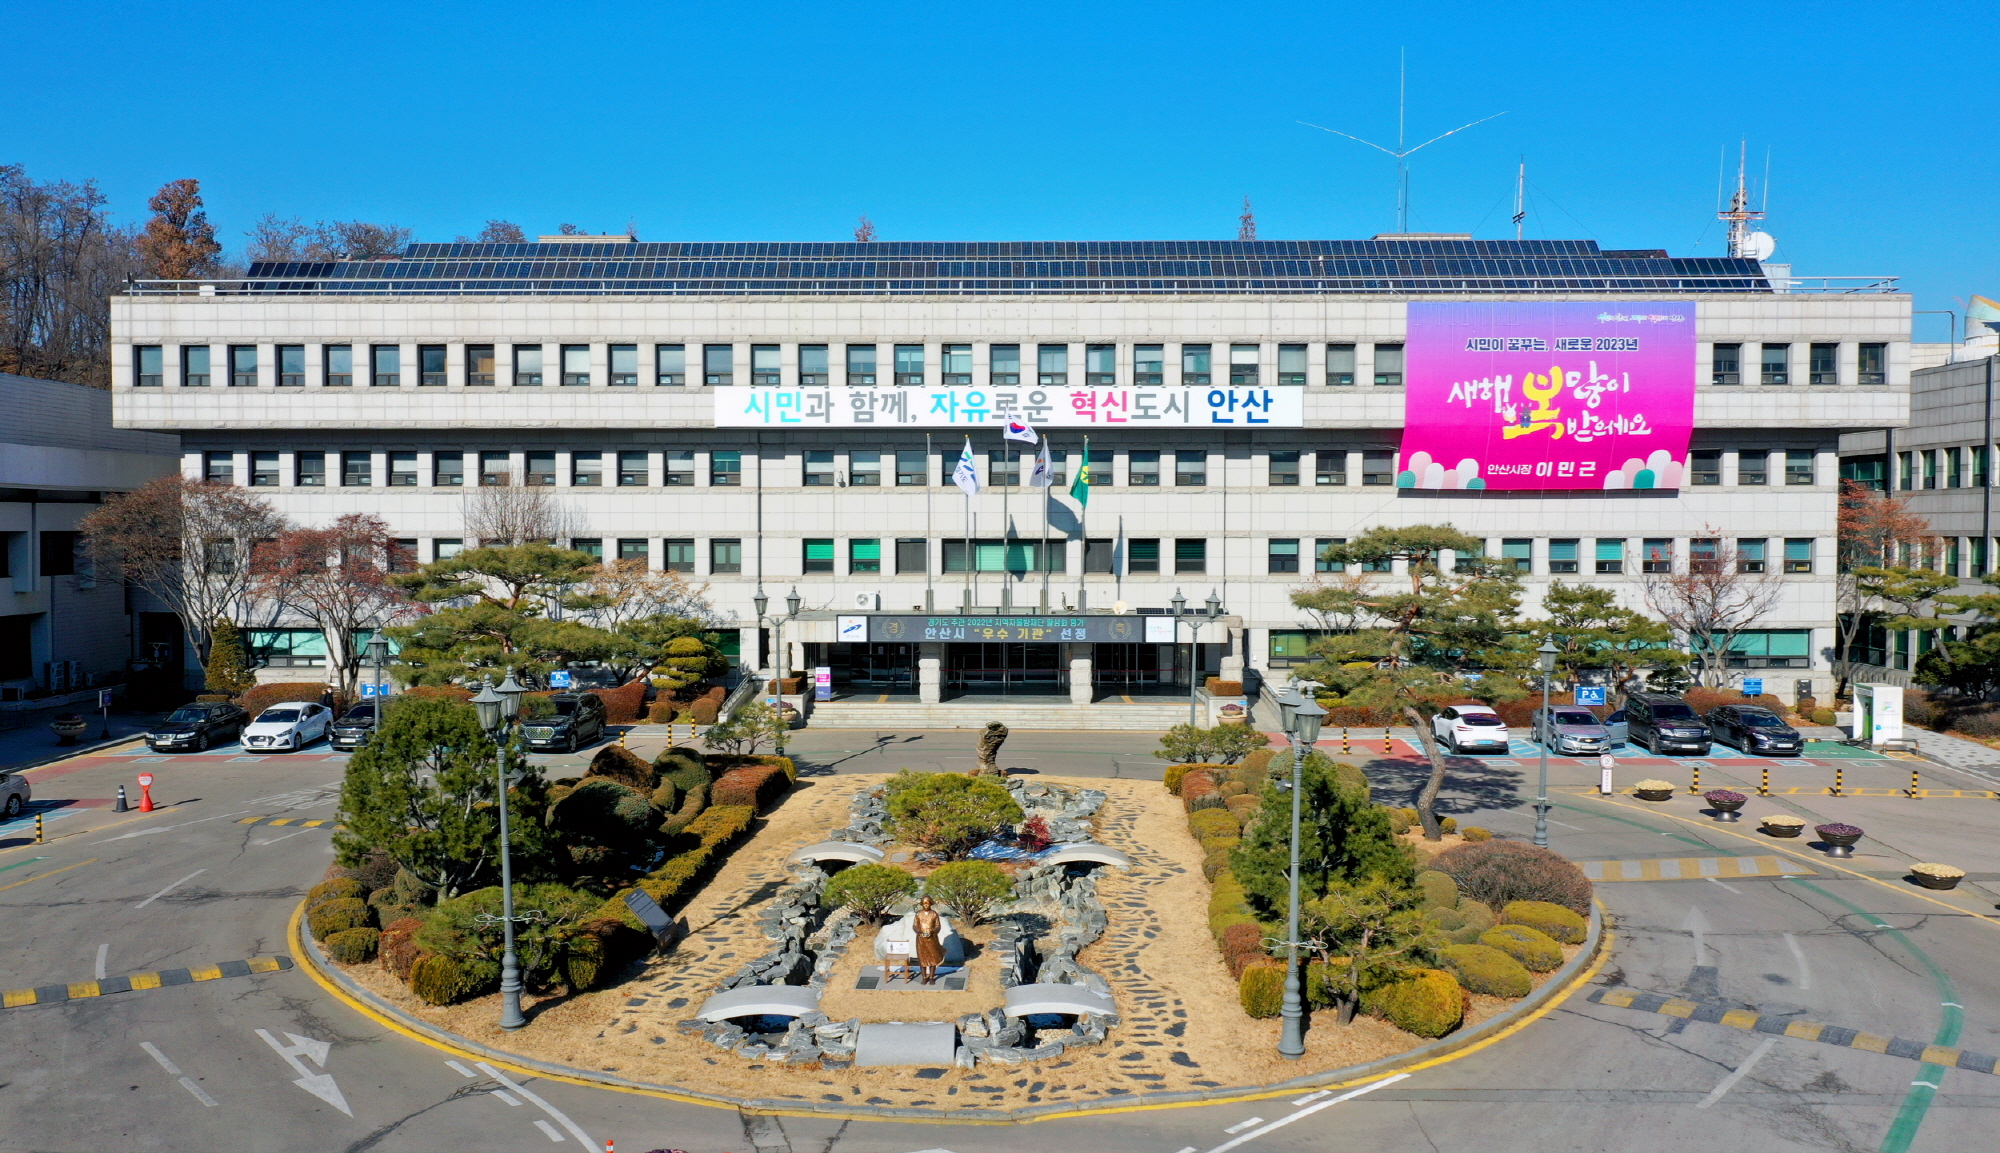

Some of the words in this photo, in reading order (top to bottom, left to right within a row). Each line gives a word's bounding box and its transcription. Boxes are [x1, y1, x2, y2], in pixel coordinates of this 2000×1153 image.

[1466, 338, 1504, 351] 시민이
[1507, 338, 1549, 351] 꿈꾸는,
[1555, 338, 1592, 351] 새로운
[1596, 338, 1639, 351] 2023년
[744, 391, 835, 423] 시민과
[849, 391, 917, 423] 함께,
[930, 391, 1053, 423] 자유로운
[1070, 391, 1189, 423] 혁신도시
[1207, 390, 1273, 423] 안산
[1447, 374, 1512, 413] 새해
[1502, 366, 1564, 440] 복
[1566, 360, 1629, 409] 많이
[1567, 410, 1652, 442] 받으세요
[1487, 464, 1532, 475] 안산시장
[928, 618, 949, 627] 경기도
[951, 618, 965, 627] 주관
[967, 618, 993, 627] 2022년
[1070, 618, 1084, 627] 평가
[925, 627, 965, 640] 안산시
[1060, 627, 1086, 640] 선정
[366, 687, 374, 696] P
[1582, 690, 1589, 699] P
